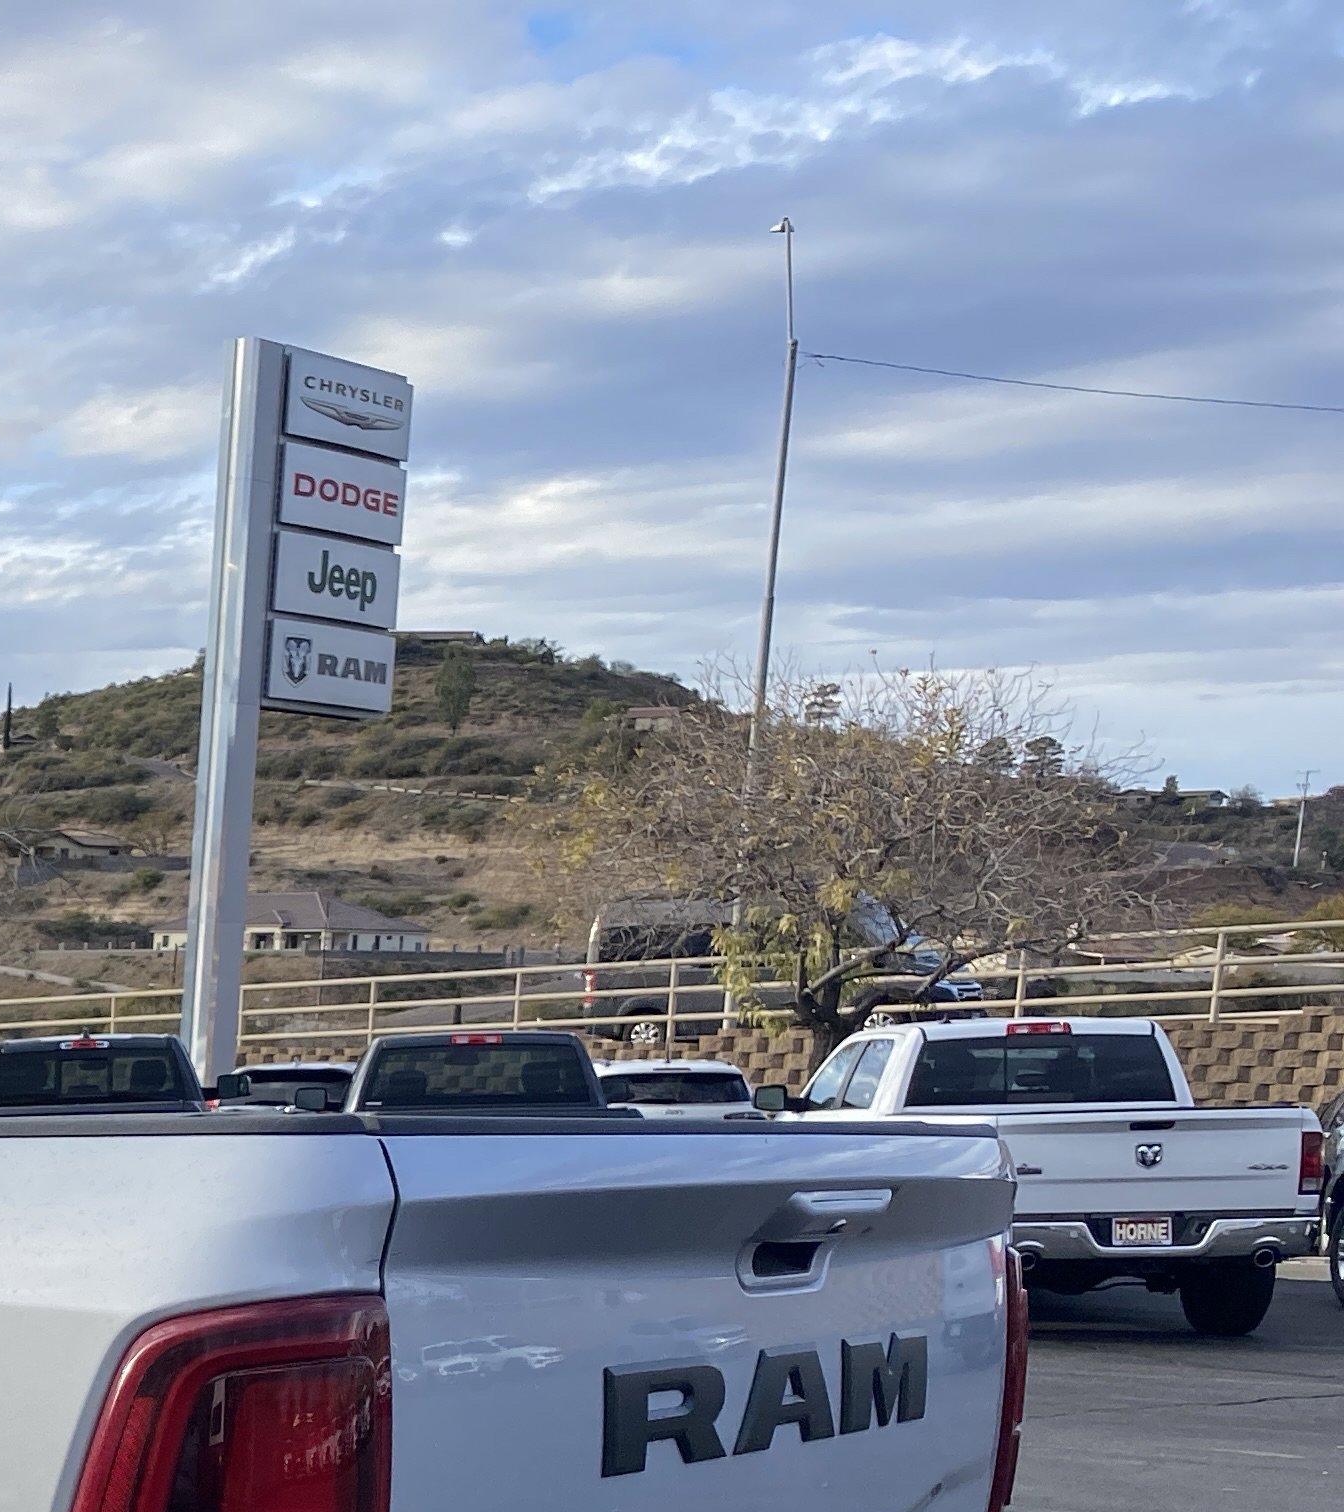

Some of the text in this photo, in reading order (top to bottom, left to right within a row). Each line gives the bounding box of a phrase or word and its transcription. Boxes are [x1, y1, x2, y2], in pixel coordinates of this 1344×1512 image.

[303, 375, 404, 413] CHRYSLER
[293, 472, 399, 517] DODGE
[307, 550, 377, 612] Jeep
[317, 653, 387, 685] RAM
[1116, 1223, 1168, 1240] HORNE
[601, 1331, 928, 1478] RAM
